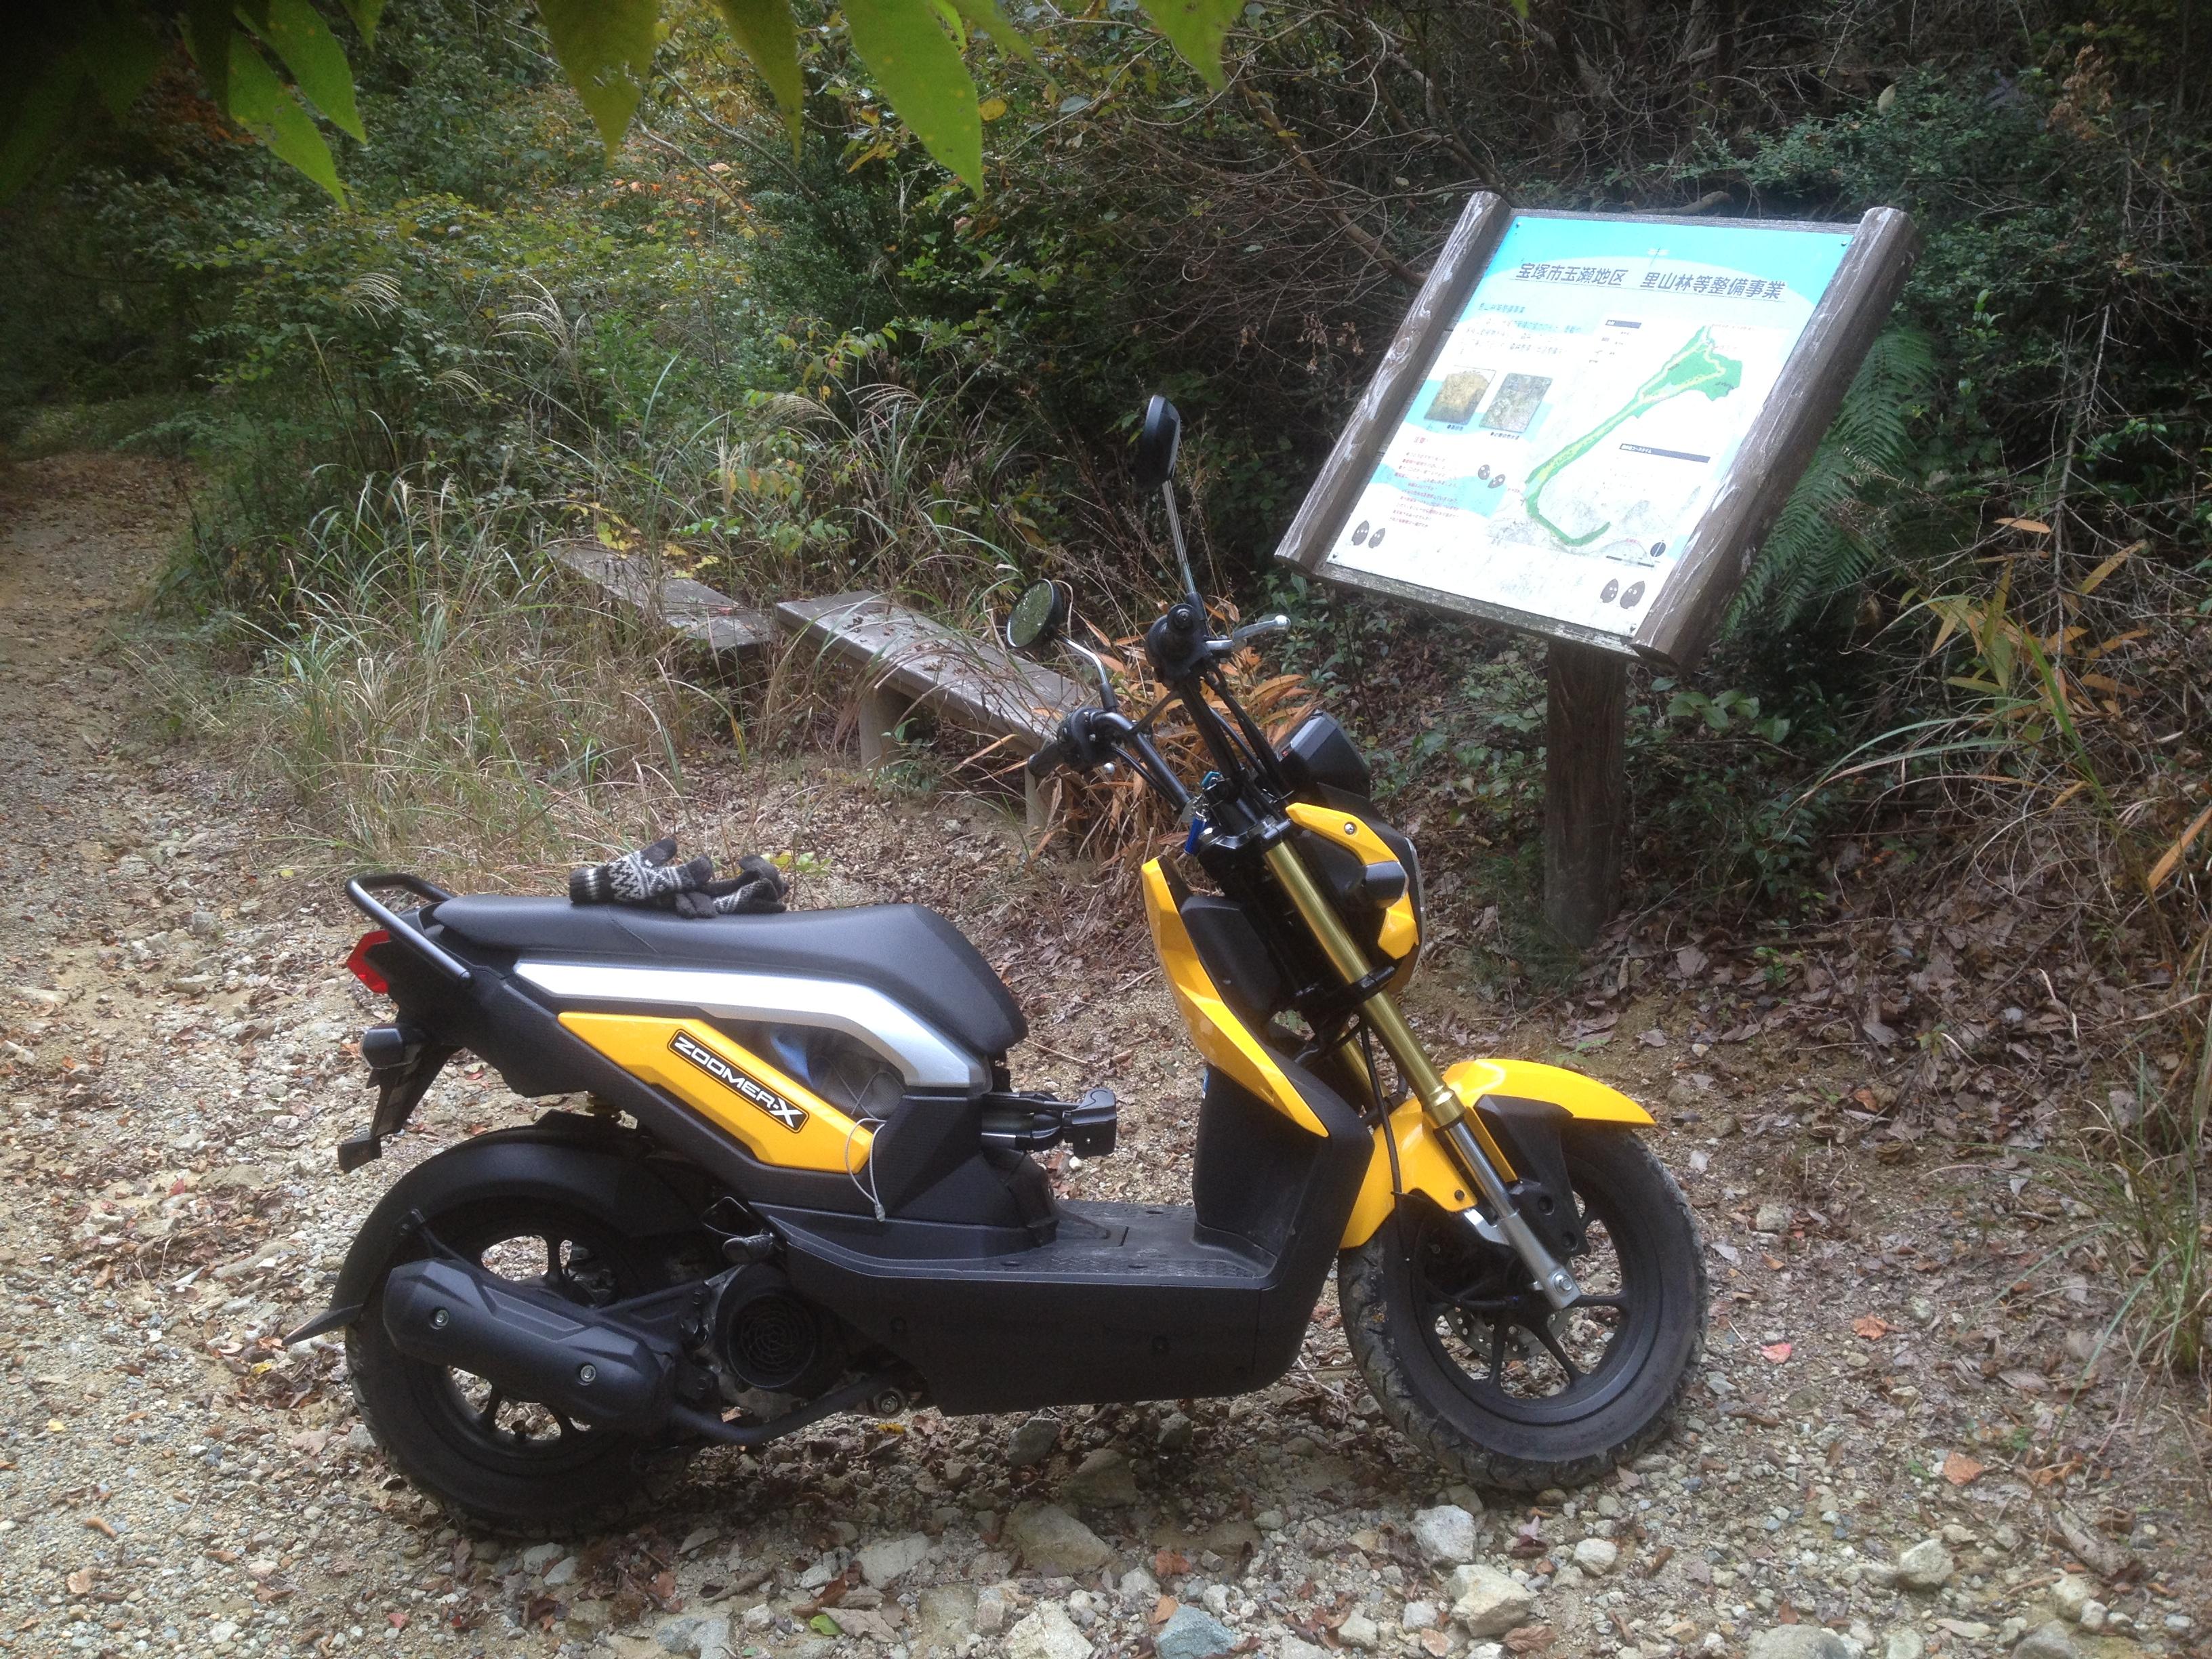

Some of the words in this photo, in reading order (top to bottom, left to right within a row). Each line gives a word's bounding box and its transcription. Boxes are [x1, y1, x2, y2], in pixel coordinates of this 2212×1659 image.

[1639, 271, 1786, 300] 里山林等整備事業
[674, 1036, 804, 1128] ZOOMER-X
